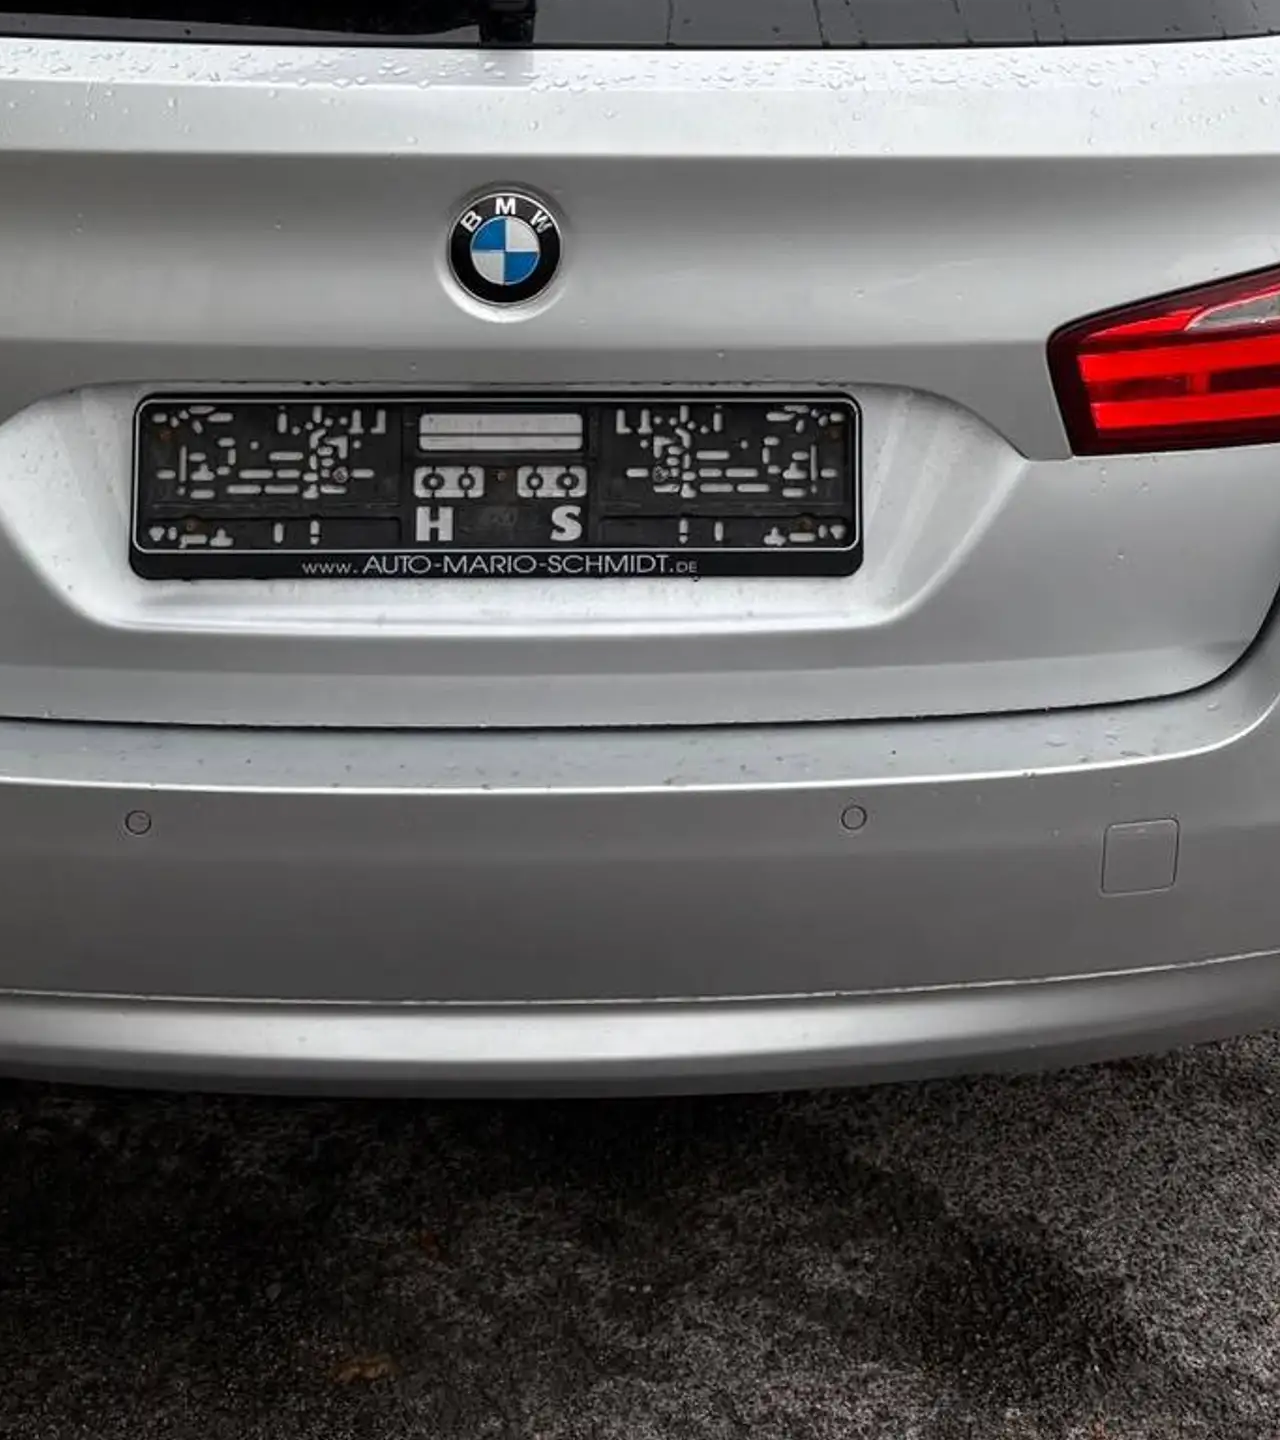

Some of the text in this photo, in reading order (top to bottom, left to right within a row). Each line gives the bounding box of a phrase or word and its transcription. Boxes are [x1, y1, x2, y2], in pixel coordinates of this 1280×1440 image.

[460, 197, 553, 233] BMW
[415, 504, 583, 542] H S
